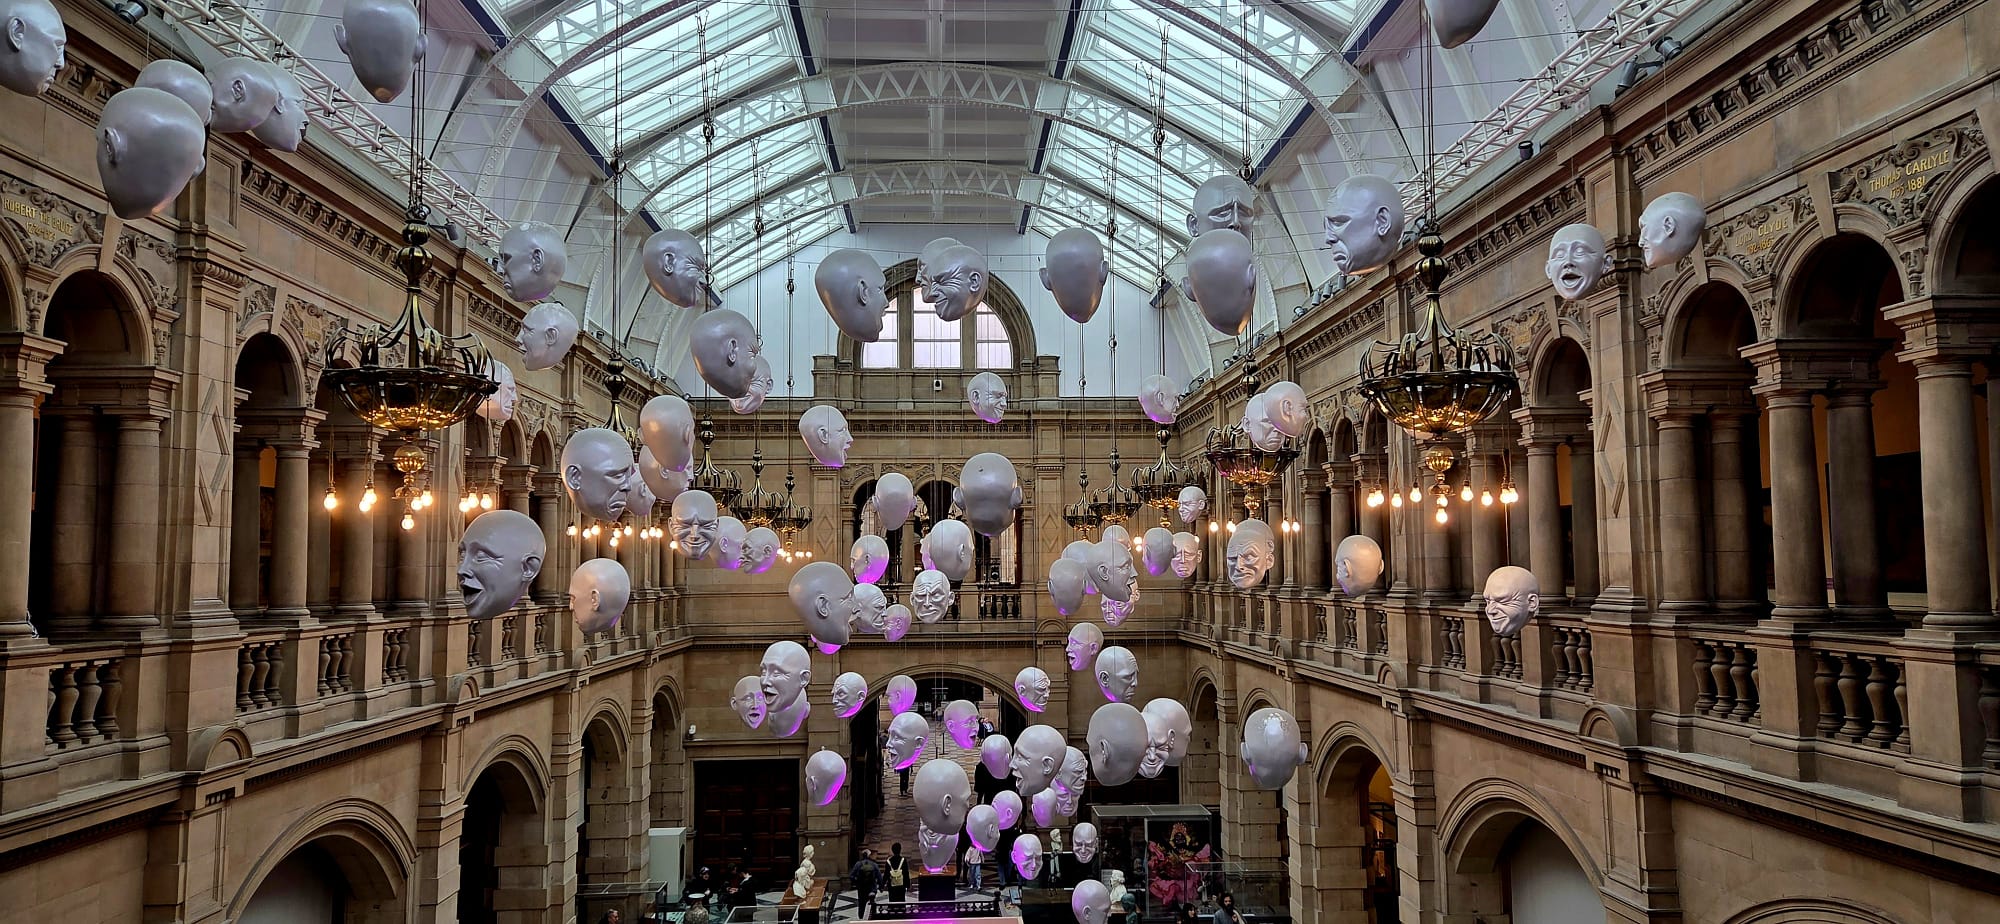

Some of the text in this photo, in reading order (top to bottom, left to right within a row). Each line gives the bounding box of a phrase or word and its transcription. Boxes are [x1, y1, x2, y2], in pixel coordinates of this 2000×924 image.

[1868, 149, 1950, 192] THOMAS CARLYLE
[4, 198, 74, 236] ROBERT THE BRUCE
[1758, 216, 1789, 237] CLYDE
